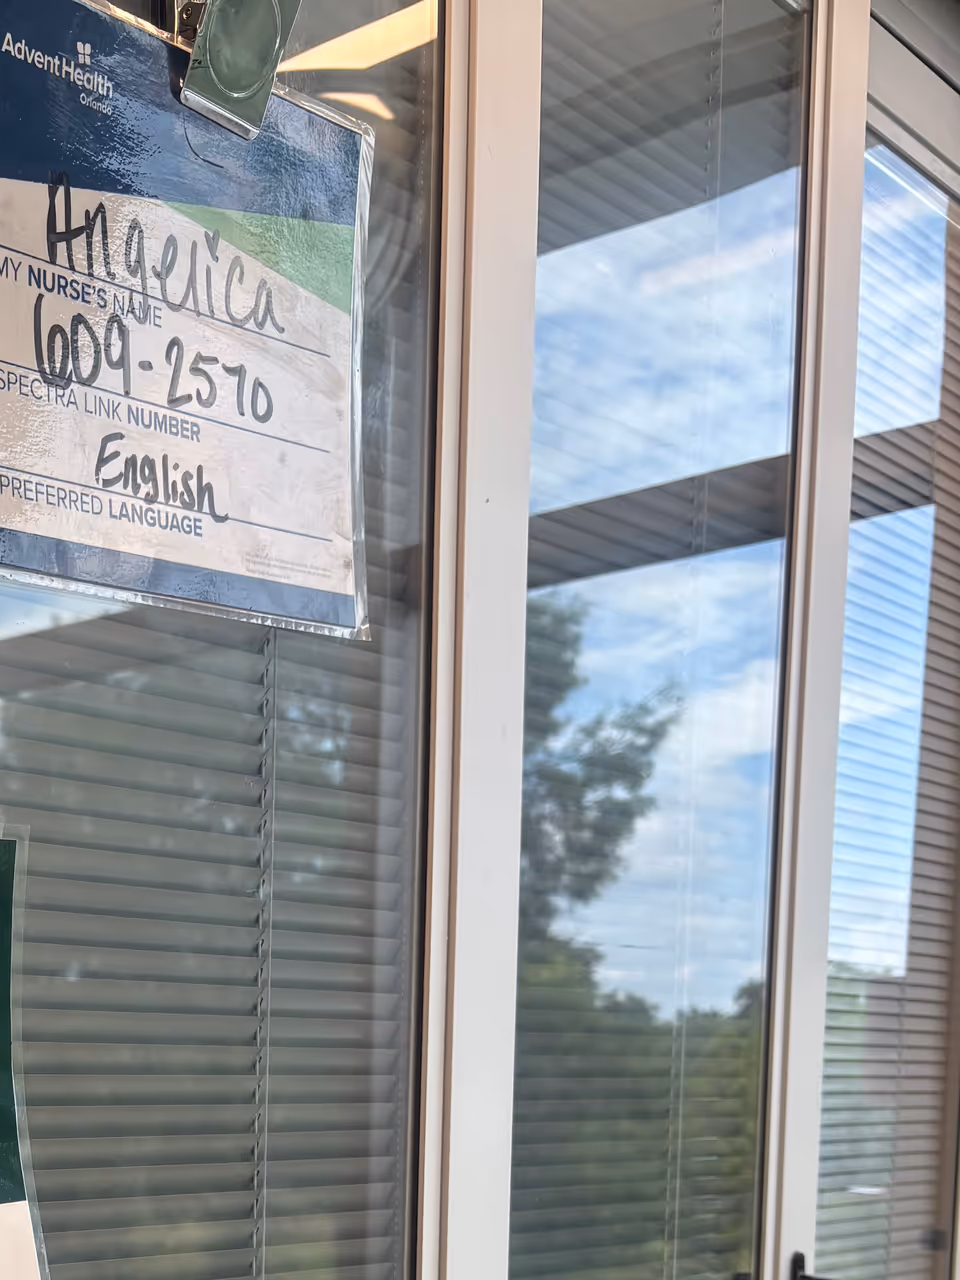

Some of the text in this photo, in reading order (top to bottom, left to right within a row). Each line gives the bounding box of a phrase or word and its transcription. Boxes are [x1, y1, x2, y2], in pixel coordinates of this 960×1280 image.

[1, 33, 113, 97] AdventHealth
[80, 93, 112, 116] Orlando
[46, 170, 284, 334] Angelica
[28, 267, 106, 307] NURSE'S
[112, 293, 162, 328] NAME
[34, 294, 273, 423] 609-2570
[85, 394, 122, 424] LINK
[127, 404, 200, 442] NUMBER
[0, 474, 202, 537] PREFERRED LANGUAGE
[96, 432, 228, 523] English
